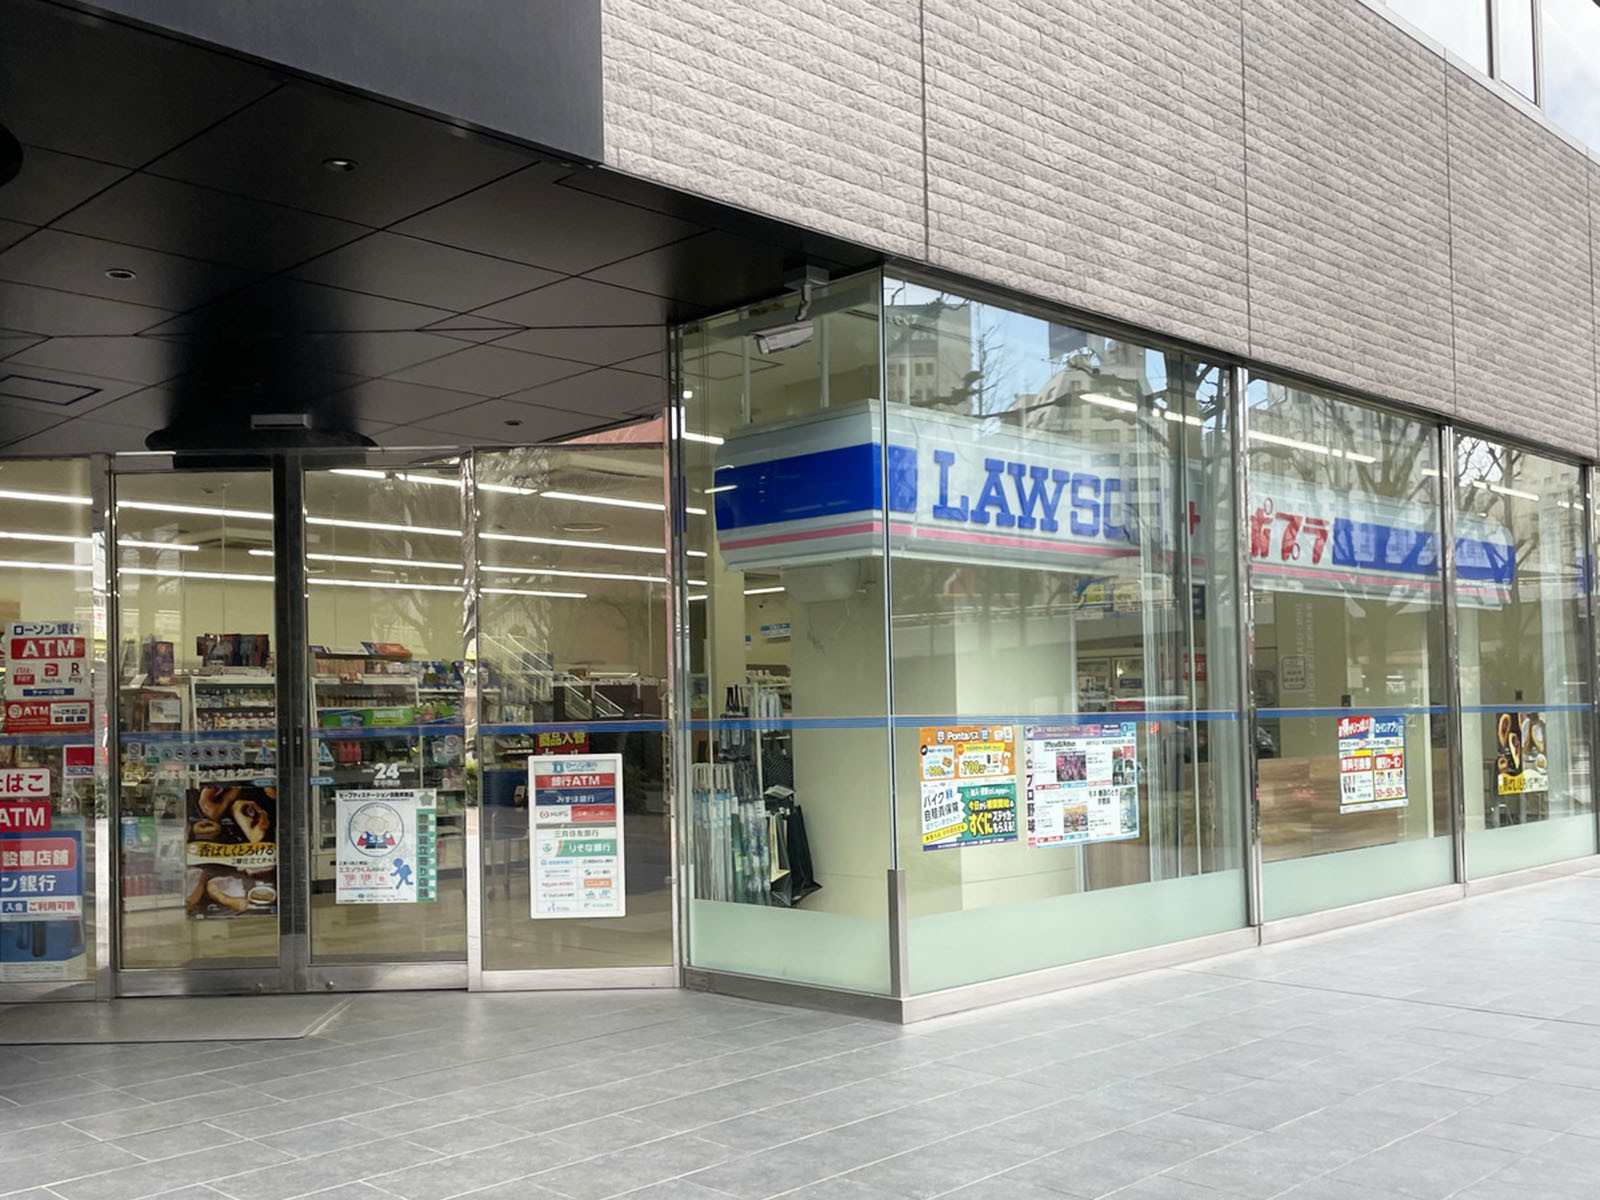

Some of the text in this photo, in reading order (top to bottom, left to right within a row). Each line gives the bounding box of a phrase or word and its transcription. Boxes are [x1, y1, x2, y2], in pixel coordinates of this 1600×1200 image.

[933, 450, 1141, 540] LAWSO
[22, 639, 76, 658] ATM
[23, 705, 49, 717] ATM
[374, 763, 400, 779] 24
[0, 773, 44, 792] ばこ
[551, 776, 600, 787] 銀行ATM
[556, 795, 595, 803] みずほ銀行
[923, 792, 944, 808] バイク
[1026, 775, 1036, 833] プロ野球
[0, 807, 45, 827] ATM
[968, 812, 993, 836] すぐに
[200, 845, 275, 857] 香ばしくとろける
[569, 843, 610, 852] りそな銀行
